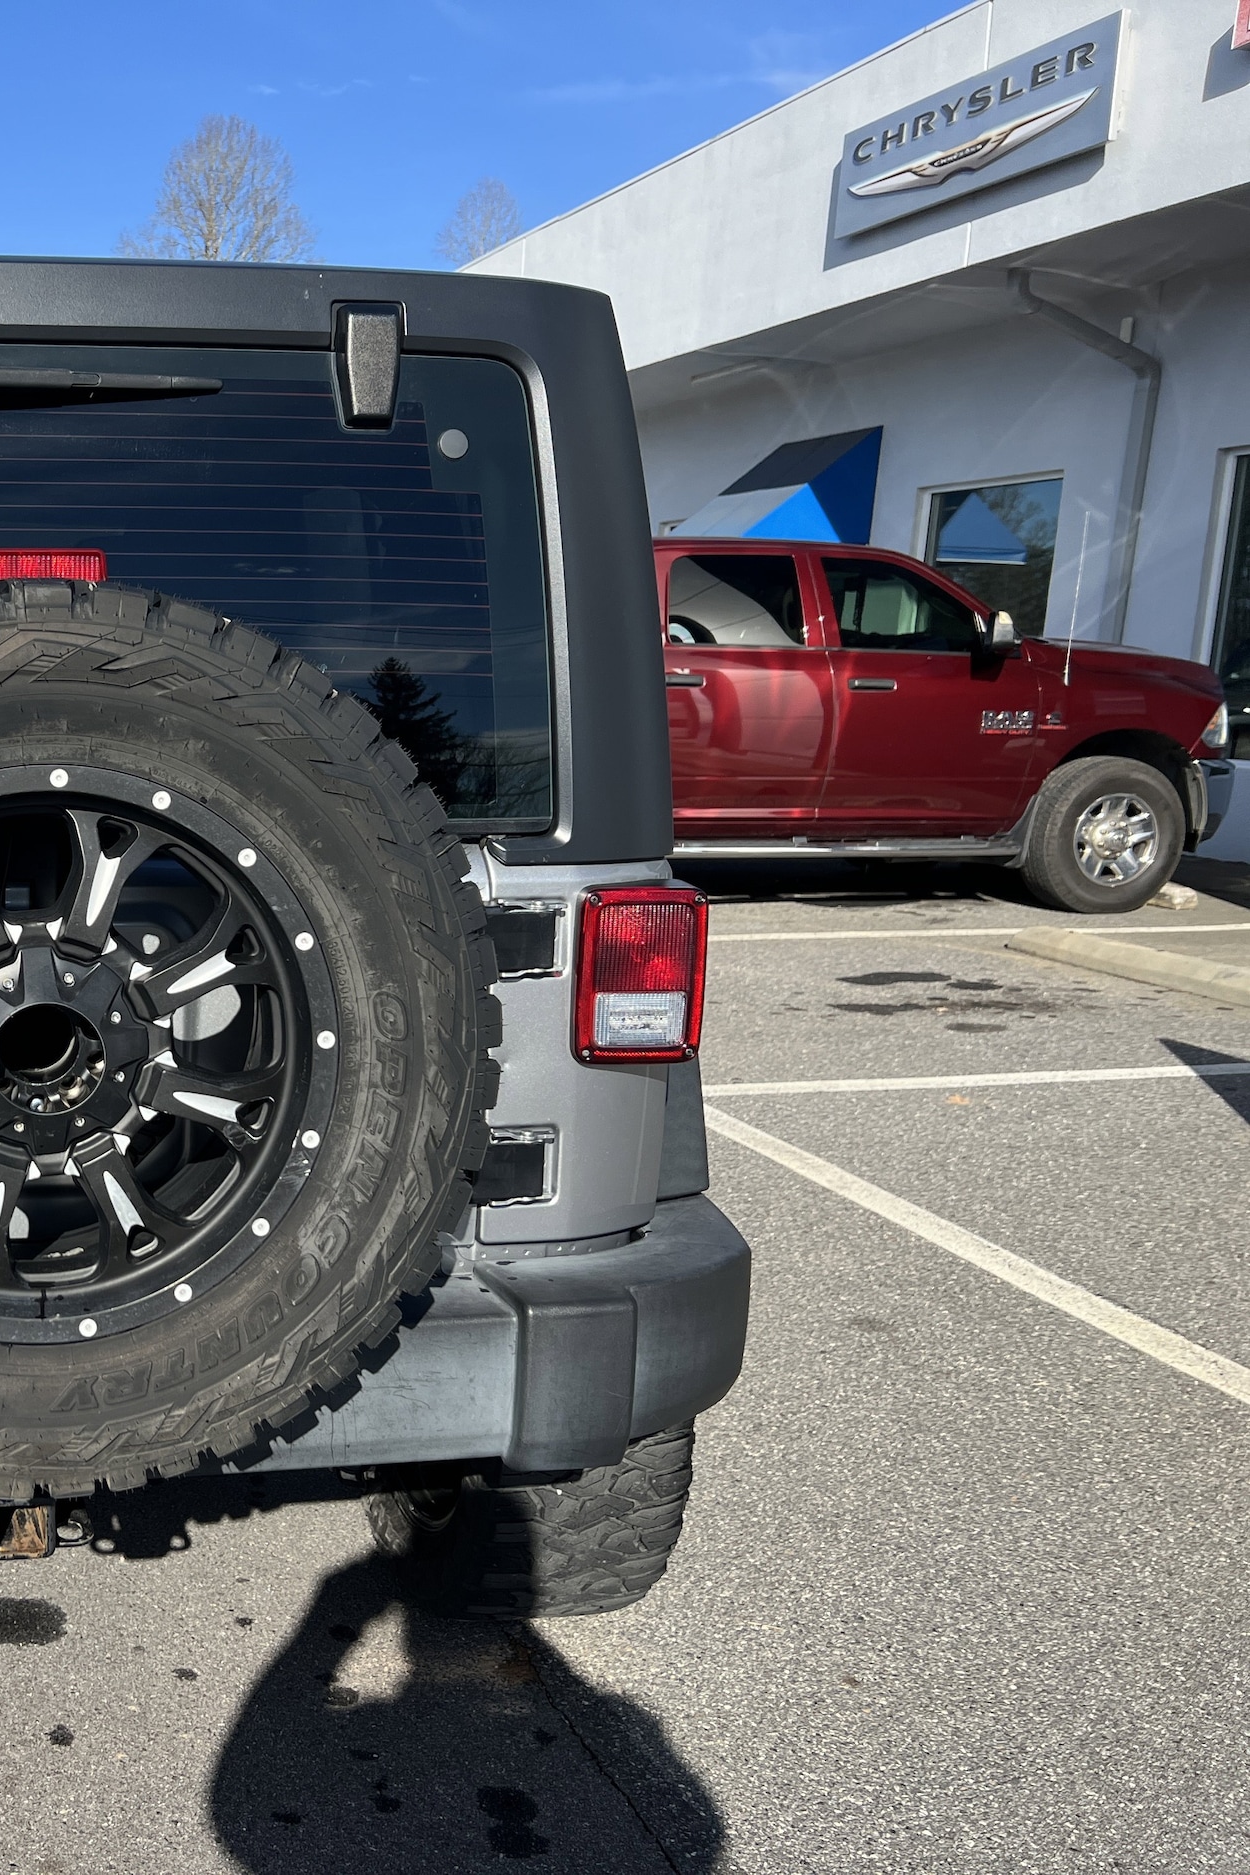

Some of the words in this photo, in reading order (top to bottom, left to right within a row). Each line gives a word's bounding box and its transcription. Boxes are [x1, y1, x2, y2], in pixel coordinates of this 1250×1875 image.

[852, 41, 1099, 165] CHRYSLER
[348, 990, 409, 1203] OPEN
[50, 1213, 351, 1413] COUNTRY
